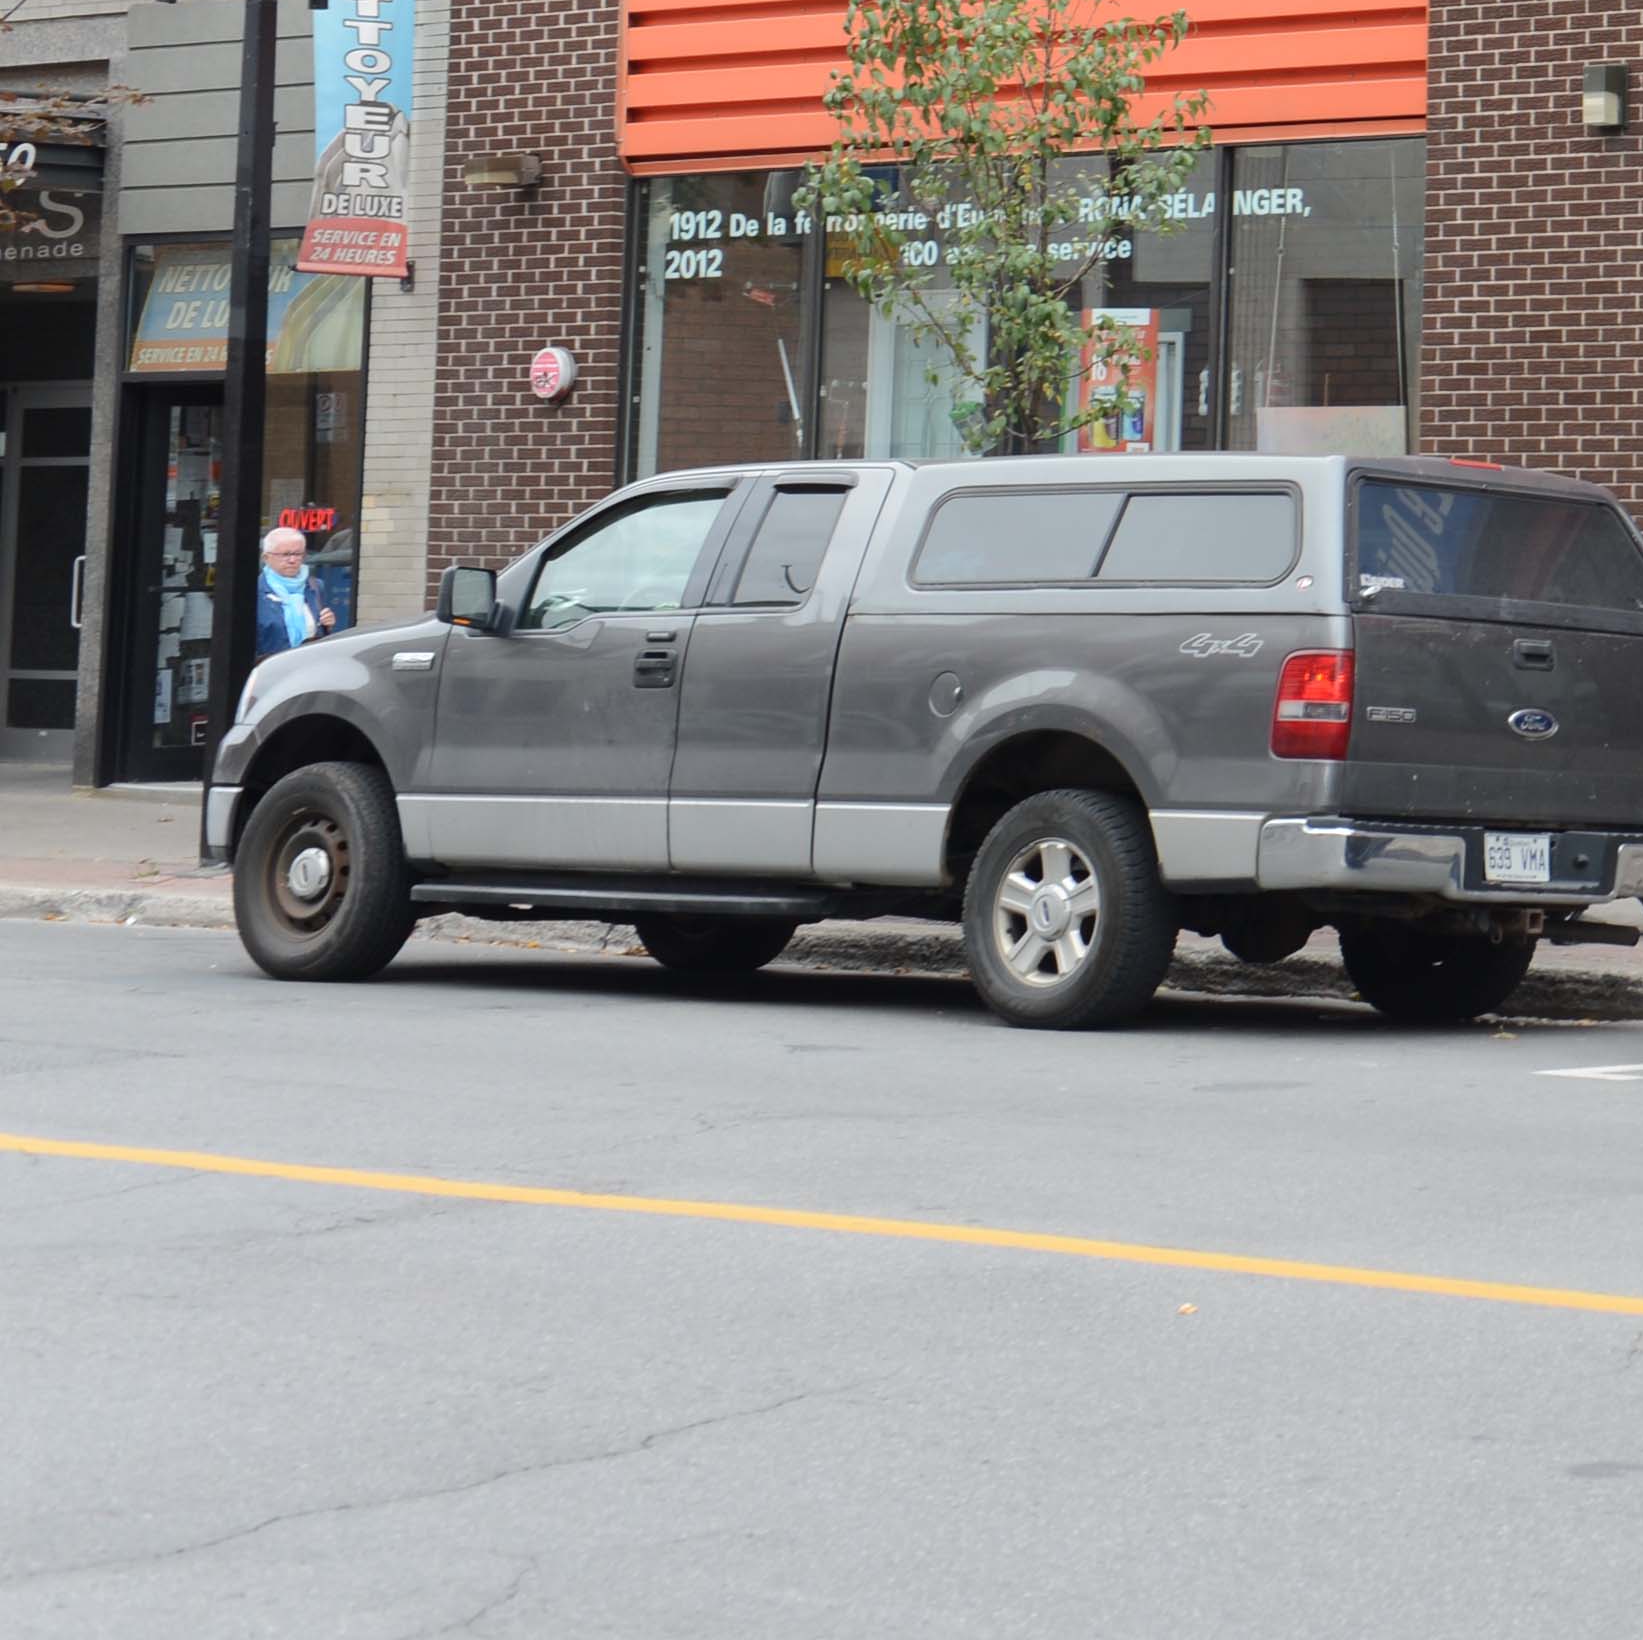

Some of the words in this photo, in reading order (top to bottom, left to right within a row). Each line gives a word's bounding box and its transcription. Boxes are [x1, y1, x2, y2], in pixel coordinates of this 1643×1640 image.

[320, 192, 351, 216] DE
[353, 194, 404, 218] LUXE
[669, 209, 723, 241] 1912
[729, 212, 760, 238] De
[767, 211, 787, 236] la
[0, 241, 85, 260] enade
[310, 229, 378, 246] SERVICE
[380, 231, 401, 247] EN
[309, 245, 331, 260] 24
[334, 246, 397, 264] HEURES
[664, 248, 724, 280] 2012
[165, 300, 202, 330] DE
[137, 347, 187, 365] SERVICE
[186, 347, 205, 363] EN
[279, 507, 337, 532] OUVERT
[1178, 631, 1265, 658] 4x4
[1488, 846, 1512, 871] 639
[1521, 846, 1547, 871] VMA
